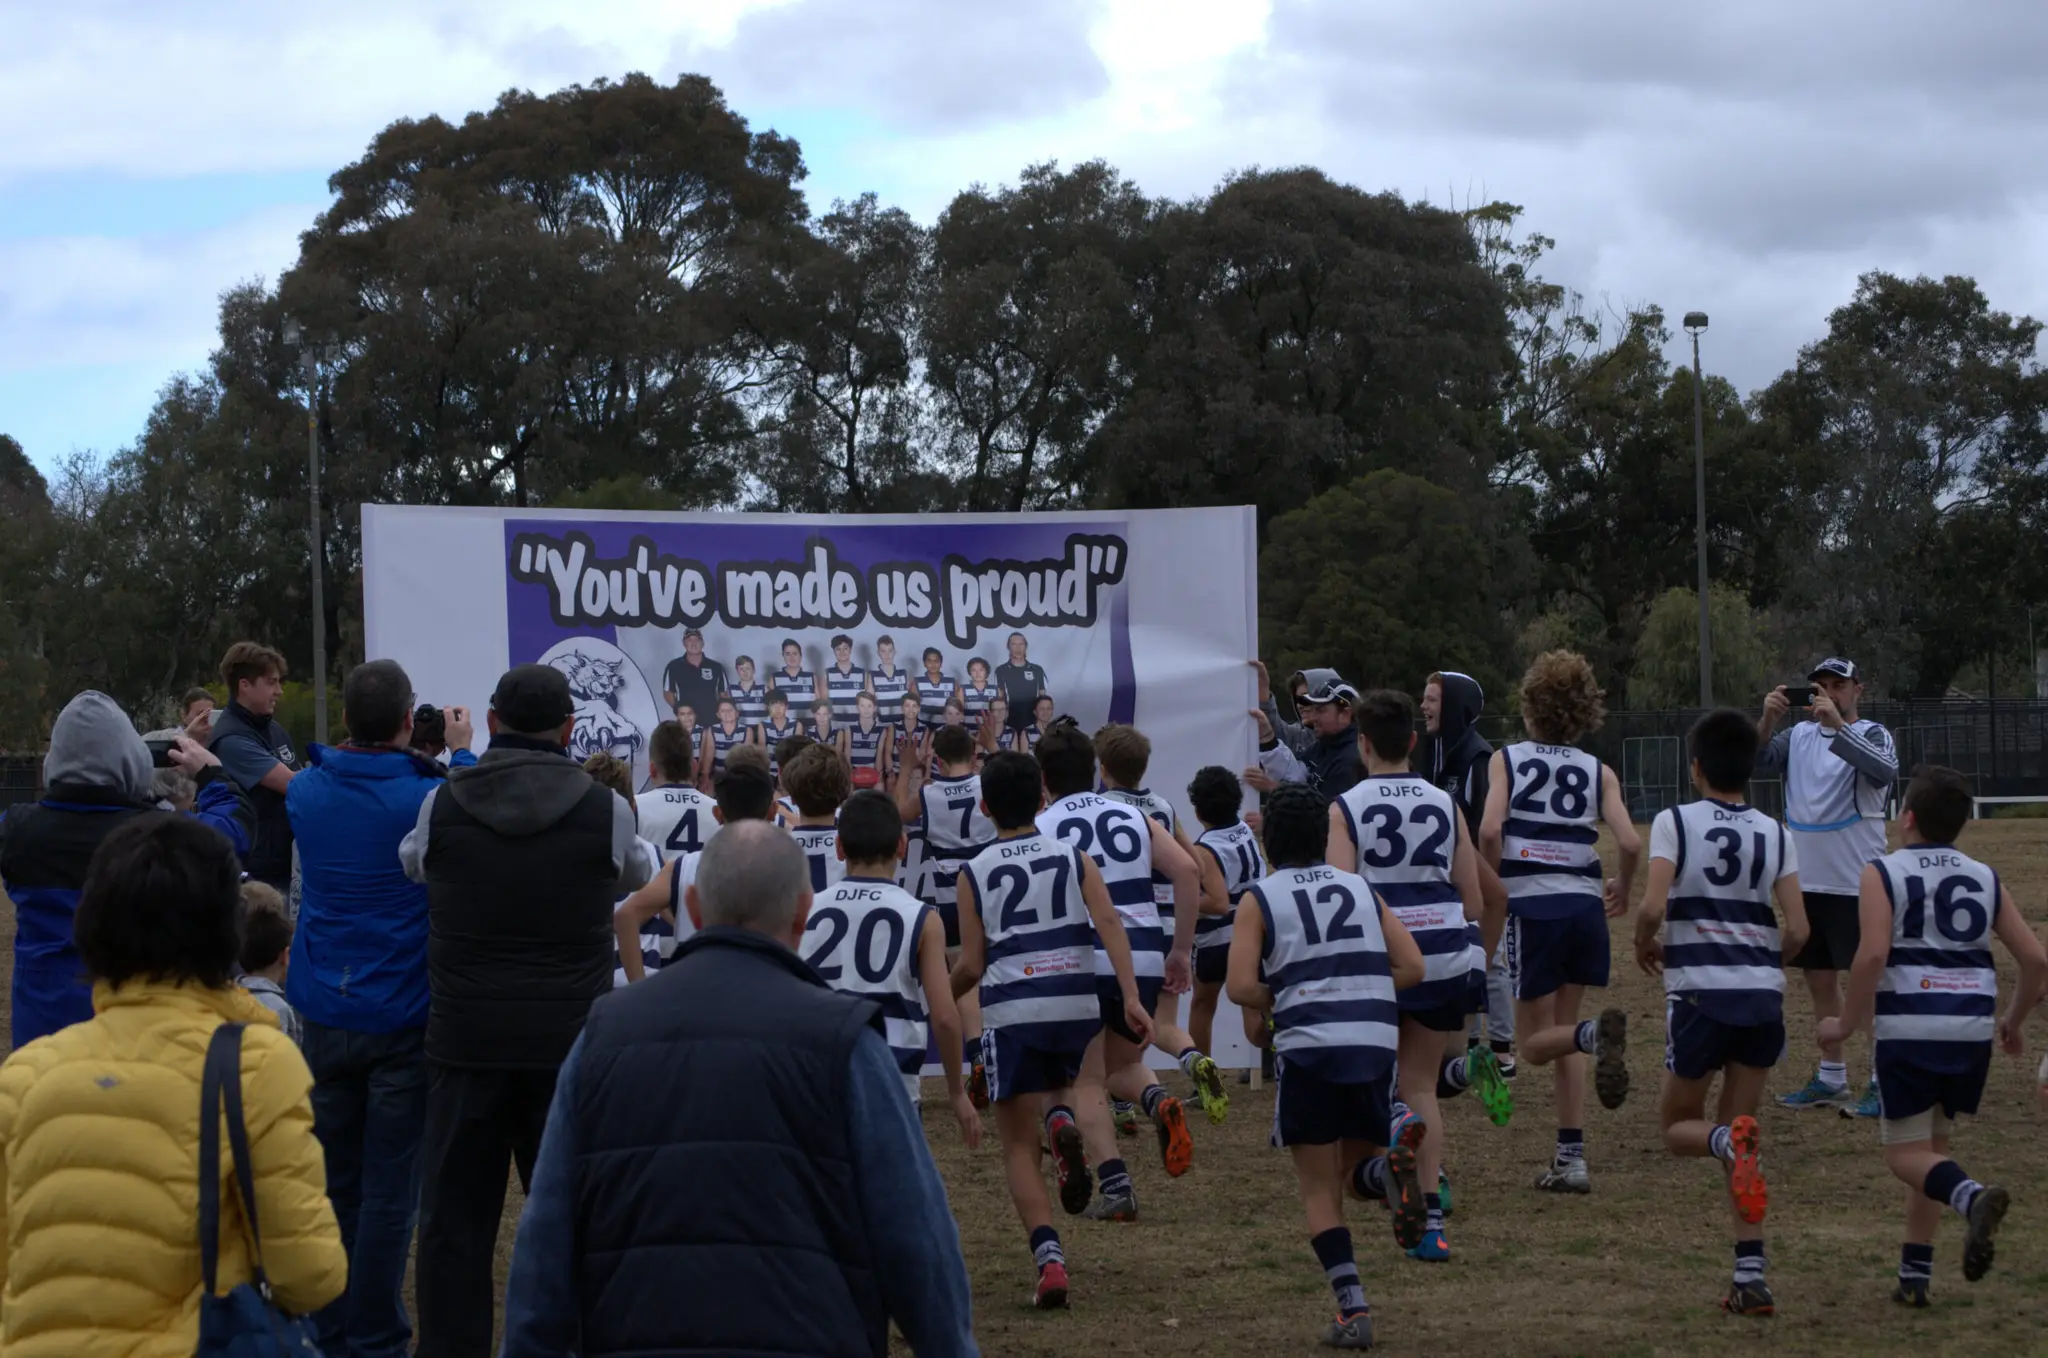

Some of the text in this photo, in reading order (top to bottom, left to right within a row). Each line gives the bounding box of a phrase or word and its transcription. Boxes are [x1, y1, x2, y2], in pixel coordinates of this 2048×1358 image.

[724, 544, 859, 620] made
[876, 569, 933, 619] us
[949, 542, 1119, 640] proud"
[1536, 746, 1572, 758] DJFC
[665, 793, 700, 804] DJFC
[944, 784, 973, 797] DJFC
[1065, 796, 1106, 811] DJFC
[1379, 785, 1424, 798] DJFC
[1511, 758, 1589, 819] 28
[666, 808, 704, 853] 4
[948, 796, 976, 839] 7
[1057, 809, 1142, 868] 26
[1361, 803, 1450, 870] 32
[797, 837, 834, 849] DJFC
[1001, 843, 1042, 858] DJFC
[1236, 839, 1260, 883] 11
[1703, 826, 1766, 890] 31
[1919, 855, 1961, 869] DJFC
[835, 889, 881, 901] DJFC
[987, 854, 1070, 933] 27
[1293, 870, 1334, 884] DJFC
[1292, 883, 1364, 946] 12
[1903, 874, 1987, 942] 16
[806, 907, 904, 983] 20
